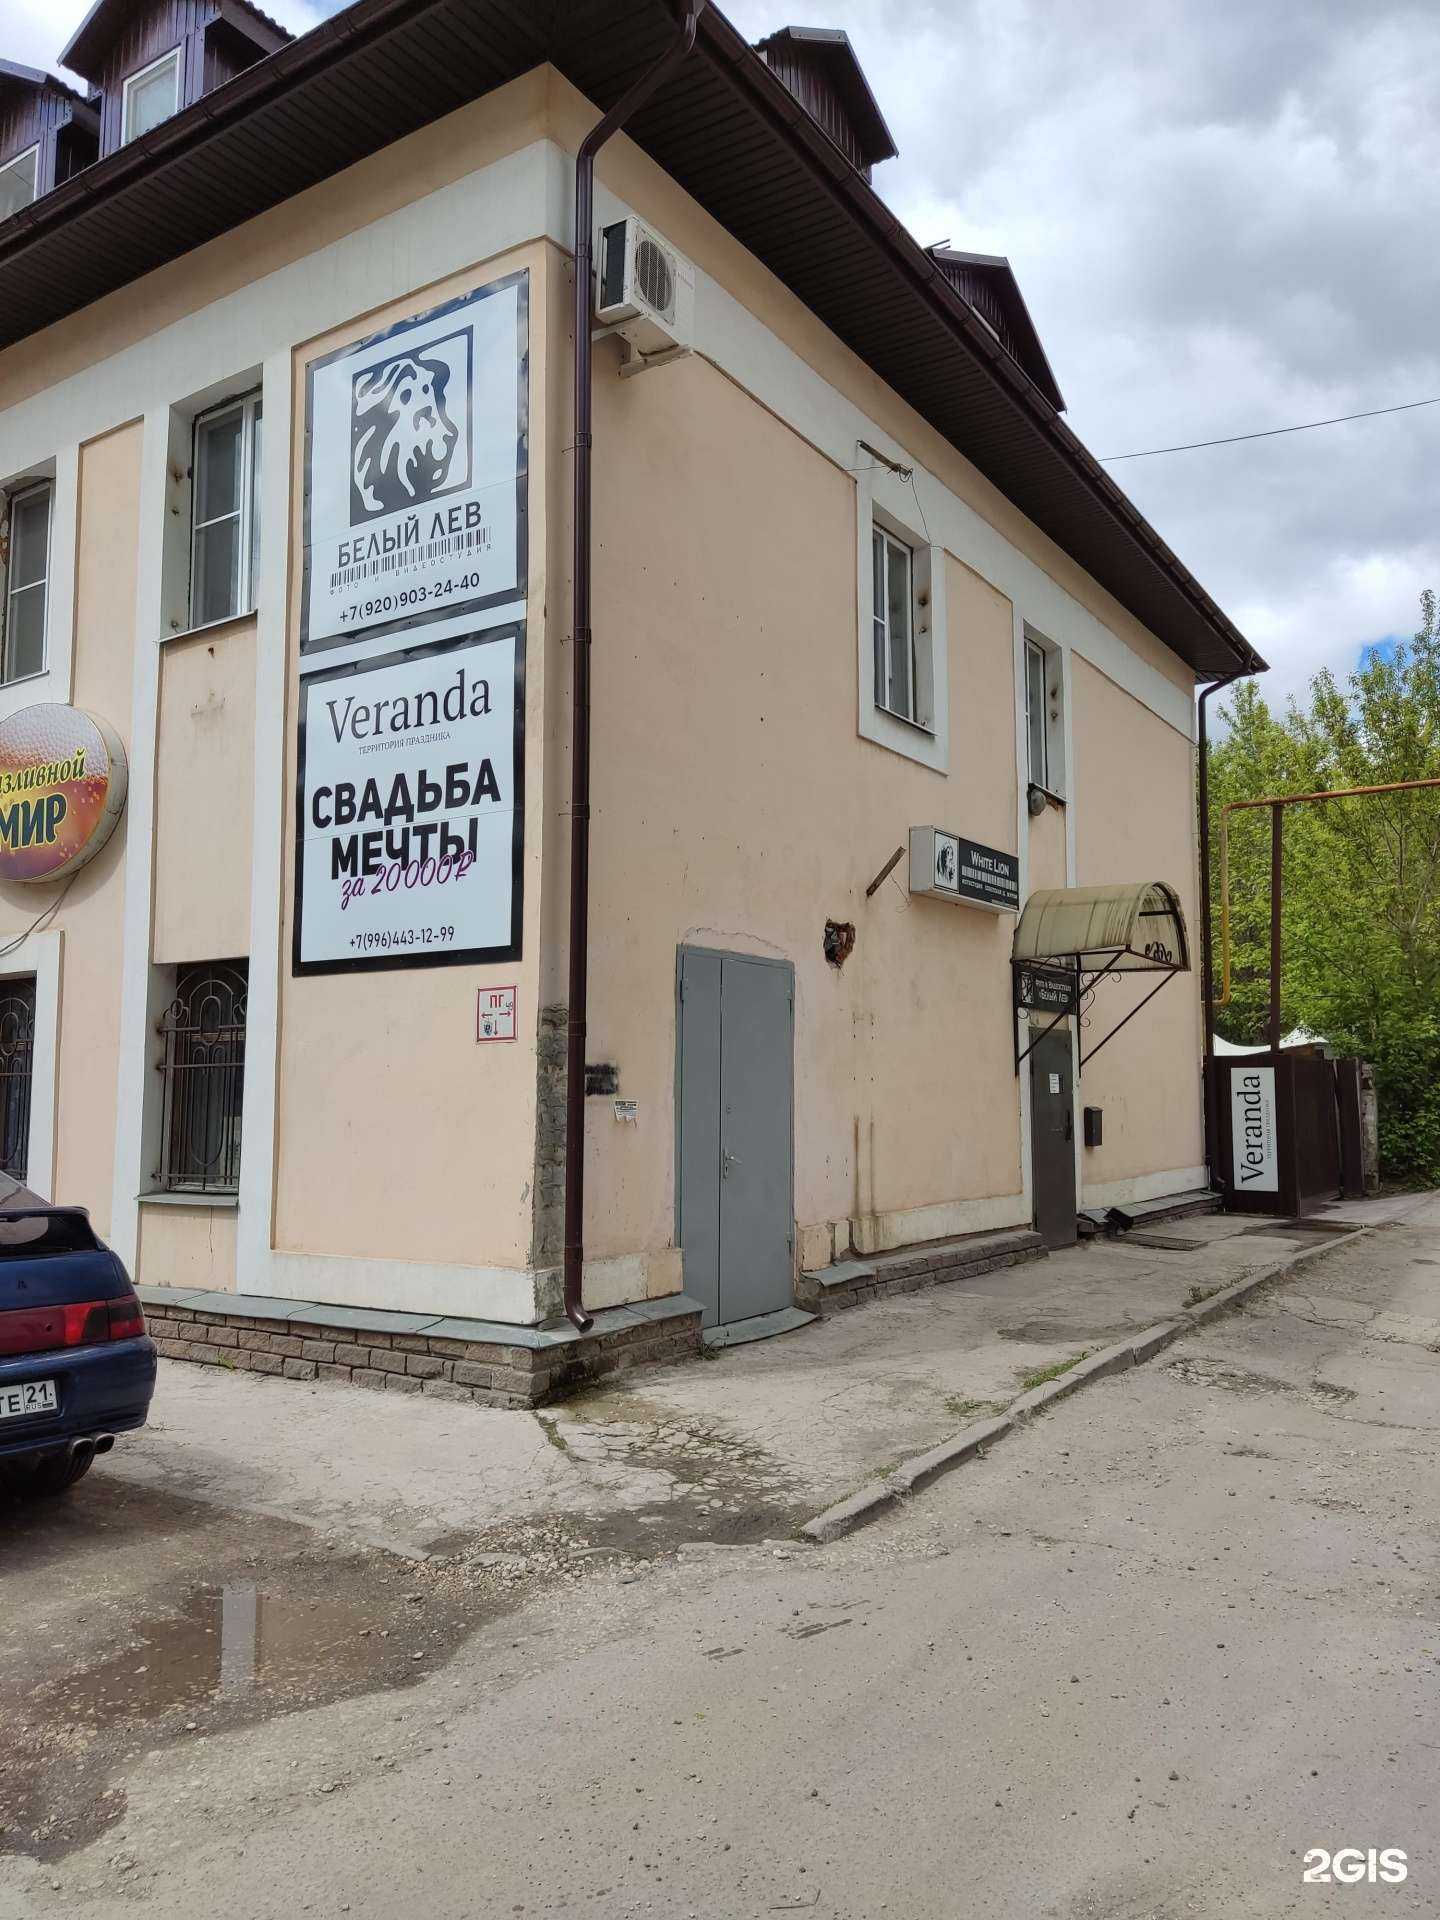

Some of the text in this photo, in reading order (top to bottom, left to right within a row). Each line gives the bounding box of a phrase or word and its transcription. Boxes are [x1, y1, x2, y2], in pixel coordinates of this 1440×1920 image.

[337, 501, 482, 568] БЕЛЫЙ ЛЕВ
[339, 572, 480, 623] +7(920)903-24-40
[326, 668, 492, 744] Veranda
[358, 731, 452, 756] ТЕРРИТОРИЯ ПРАЗДНИКА
[312, 758, 502, 829] СВАДЬБА
[331, 817, 479, 880] МЕЧТЫ
[341, 877, 366, 911] за
[350, 926, 455, 951] +7(996)443-12-99
[490, 994, 504, 1008] ПГ
[1236, 1074, 1265, 1184] Veranda
[26, 1383, 48, 1403] 21
